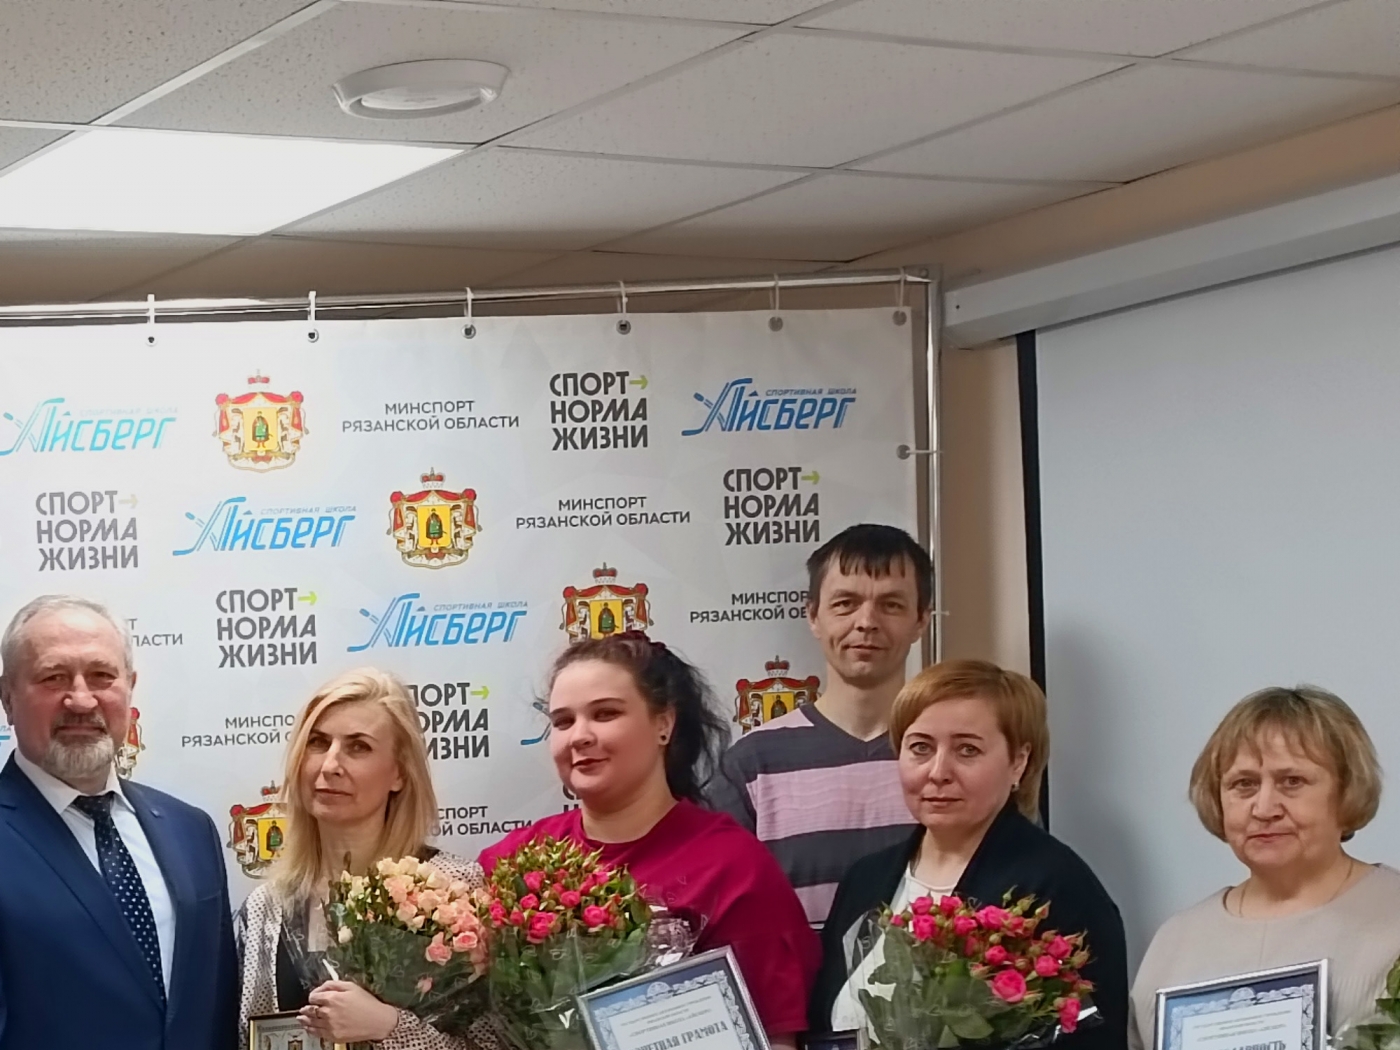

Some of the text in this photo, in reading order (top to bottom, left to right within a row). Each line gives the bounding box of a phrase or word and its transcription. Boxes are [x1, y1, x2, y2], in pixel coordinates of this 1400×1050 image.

[549, 371, 630, 397] СПОРТ
[384, 400, 475, 415] МИНСПОРТ
[550, 398, 648, 424] НОРМА
[341, 415, 520, 433] РЯЗАНСКОЙ ОБЛАСТИ
[551, 425, 649, 451] ЖИЗНИ
[723, 467, 802, 493] СПОРТ
[35, 490, 118, 516] СПОРТ
[558, 496, 647, 511] МИНСПОРТ
[724, 494, 820, 519] НОРМА
[36, 518, 138, 544] НОРМА
[515, 511, 691, 530] РЯЗАНСКОЙ ОБЛАСТИ
[724, 520, 821, 546] ЖИЗНИ
[38, 546, 139, 572] ЖИЗНИ
[215, 587, 298, 614] СПОРТ
[731, 590, 809, 605] МИНСПОР
[689, 604, 785, 623] РЯЗАНСКОЙ
[216, 614, 317, 641] НОРМА
[131, 633, 183, 648] ЛАСТИ
[218, 641, 318, 669] ЖИЗНИ
[404, 682, 471, 707] ПОРТ
[224, 714, 295, 729] МИНСПО
[418, 708, 489, 733] ОРМА
[181, 728, 281, 748] РЯЗАНСКОЙ
[427, 735, 490, 760] ИЗНИ
[437, 805, 489, 820] СПОРТ
